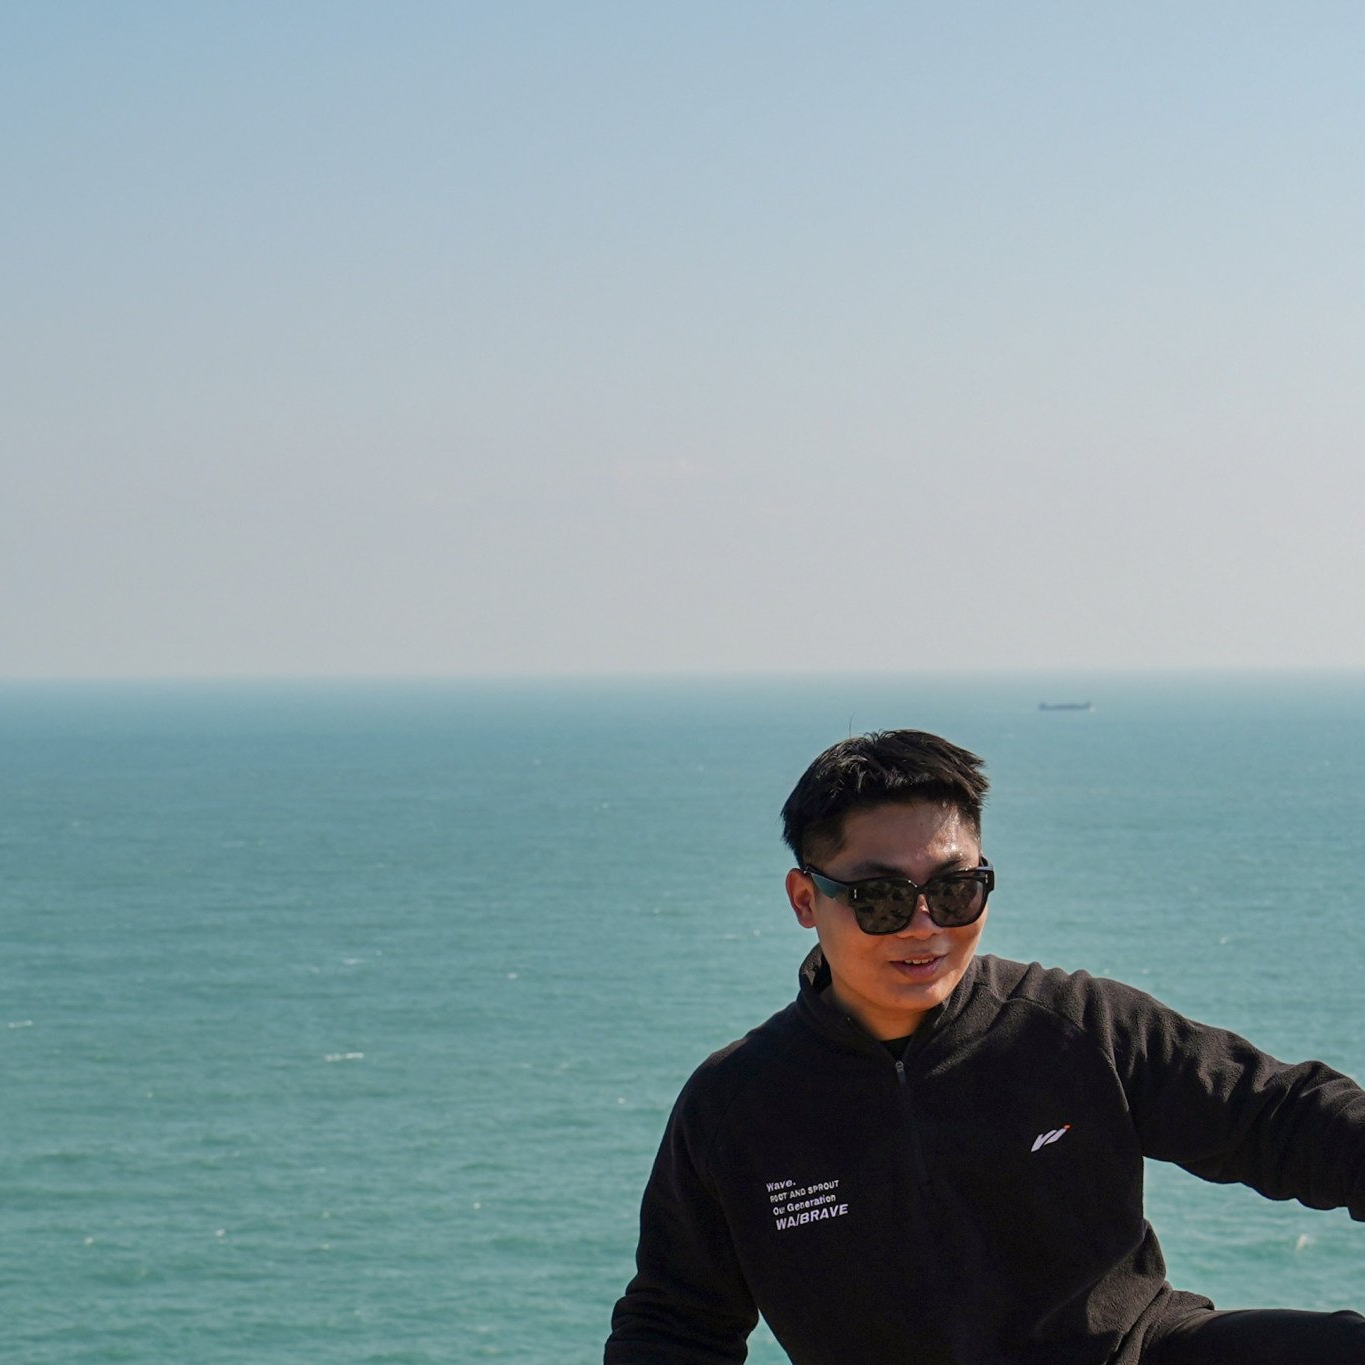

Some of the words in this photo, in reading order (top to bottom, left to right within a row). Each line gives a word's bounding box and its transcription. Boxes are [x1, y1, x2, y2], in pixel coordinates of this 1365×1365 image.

[766, 1180, 796, 1192] Wave.
[790, 1188, 806, 1199] AND
[807, 1180, 840, 1194] SPROUT
[787, 1194, 836, 1212] Generation
